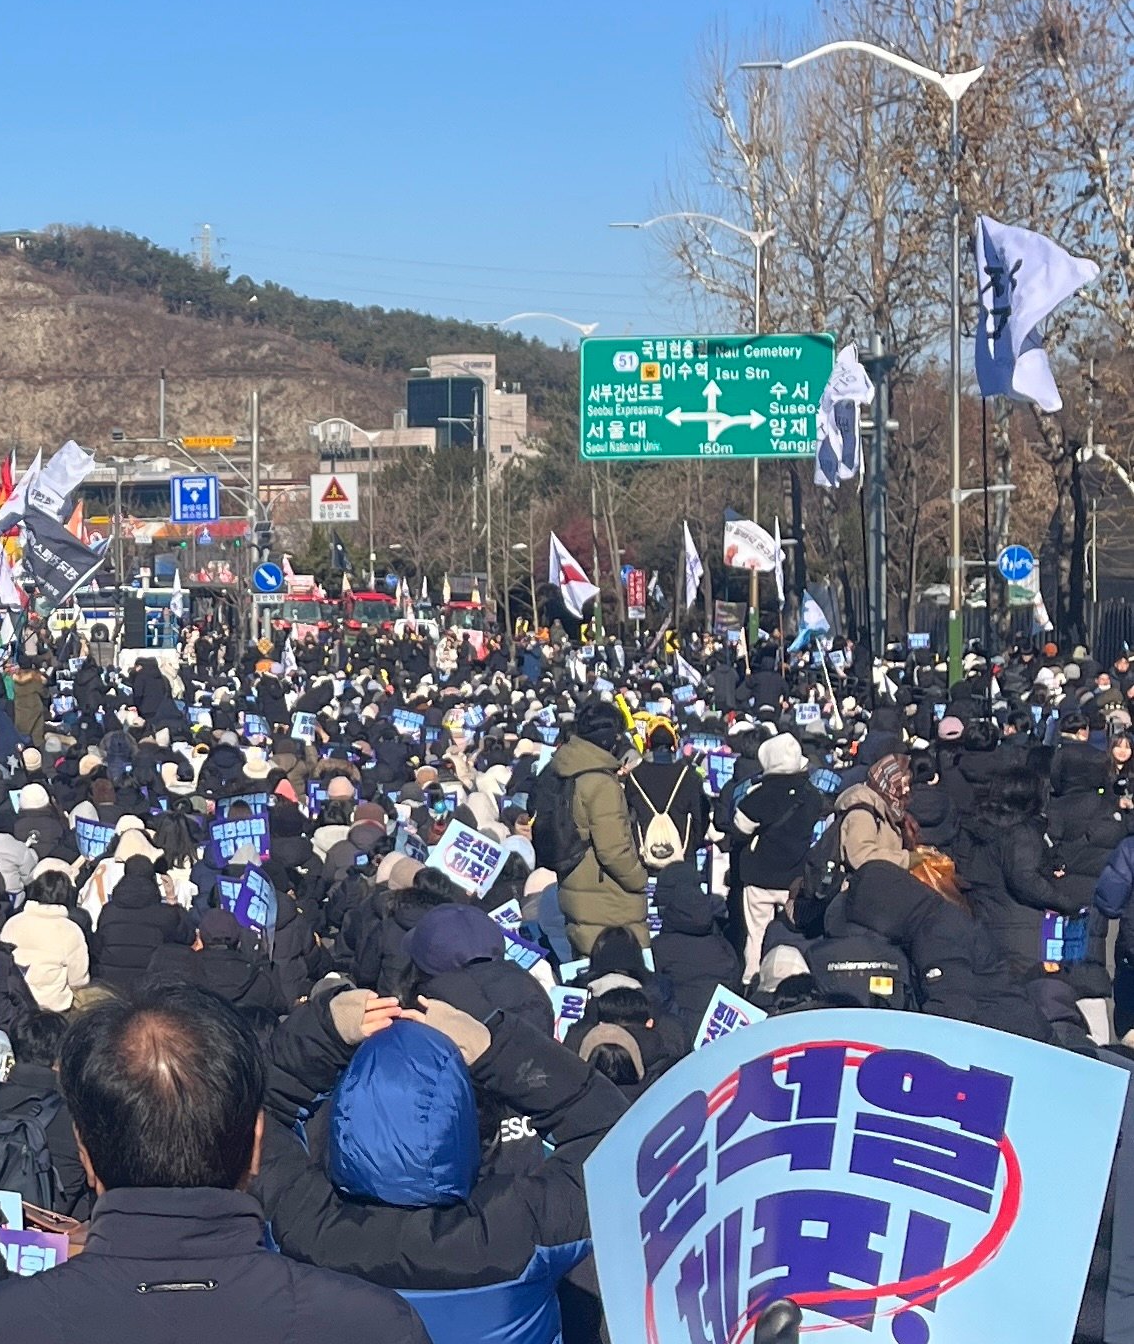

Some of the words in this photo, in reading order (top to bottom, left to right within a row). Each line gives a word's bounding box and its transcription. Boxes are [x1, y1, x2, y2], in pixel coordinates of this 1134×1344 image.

[618, 354, 634, 367] 51
[744, 344, 802, 360] Cemetery
[663, 361, 709, 381] 이수역
[716, 367, 740, 380] Isu
[745, 366, 770, 380] Stn
[587, 384, 664, 403] 서부간선도로
[769, 381, 809, 401] 수서
[586, 420, 647, 439] 서울대
[769, 417, 809, 436] 양재
[769, 438, 817, 454] Yangja
[452, 830, 502, 870] 윤석열
[449, 852, 490, 887] 체포!
[635, 1045, 1014, 1285] 윤석열
